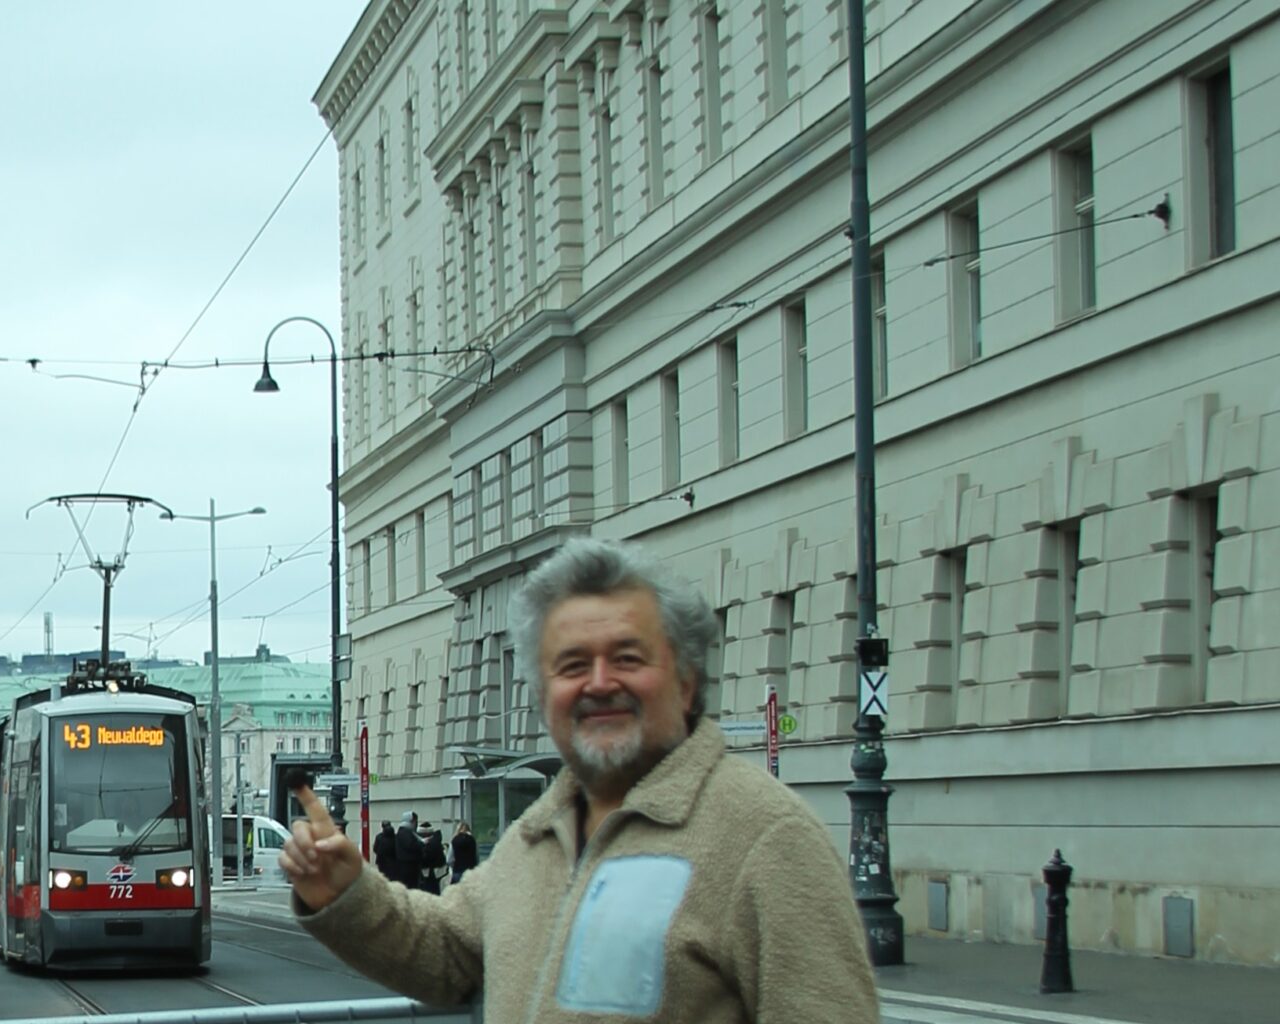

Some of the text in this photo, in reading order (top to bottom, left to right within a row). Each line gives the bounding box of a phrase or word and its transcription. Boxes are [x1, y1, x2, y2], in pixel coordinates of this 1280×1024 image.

[64, 724, 164, 748] 43 Neuwaldegg
[109, 885, 133, 898] 772
